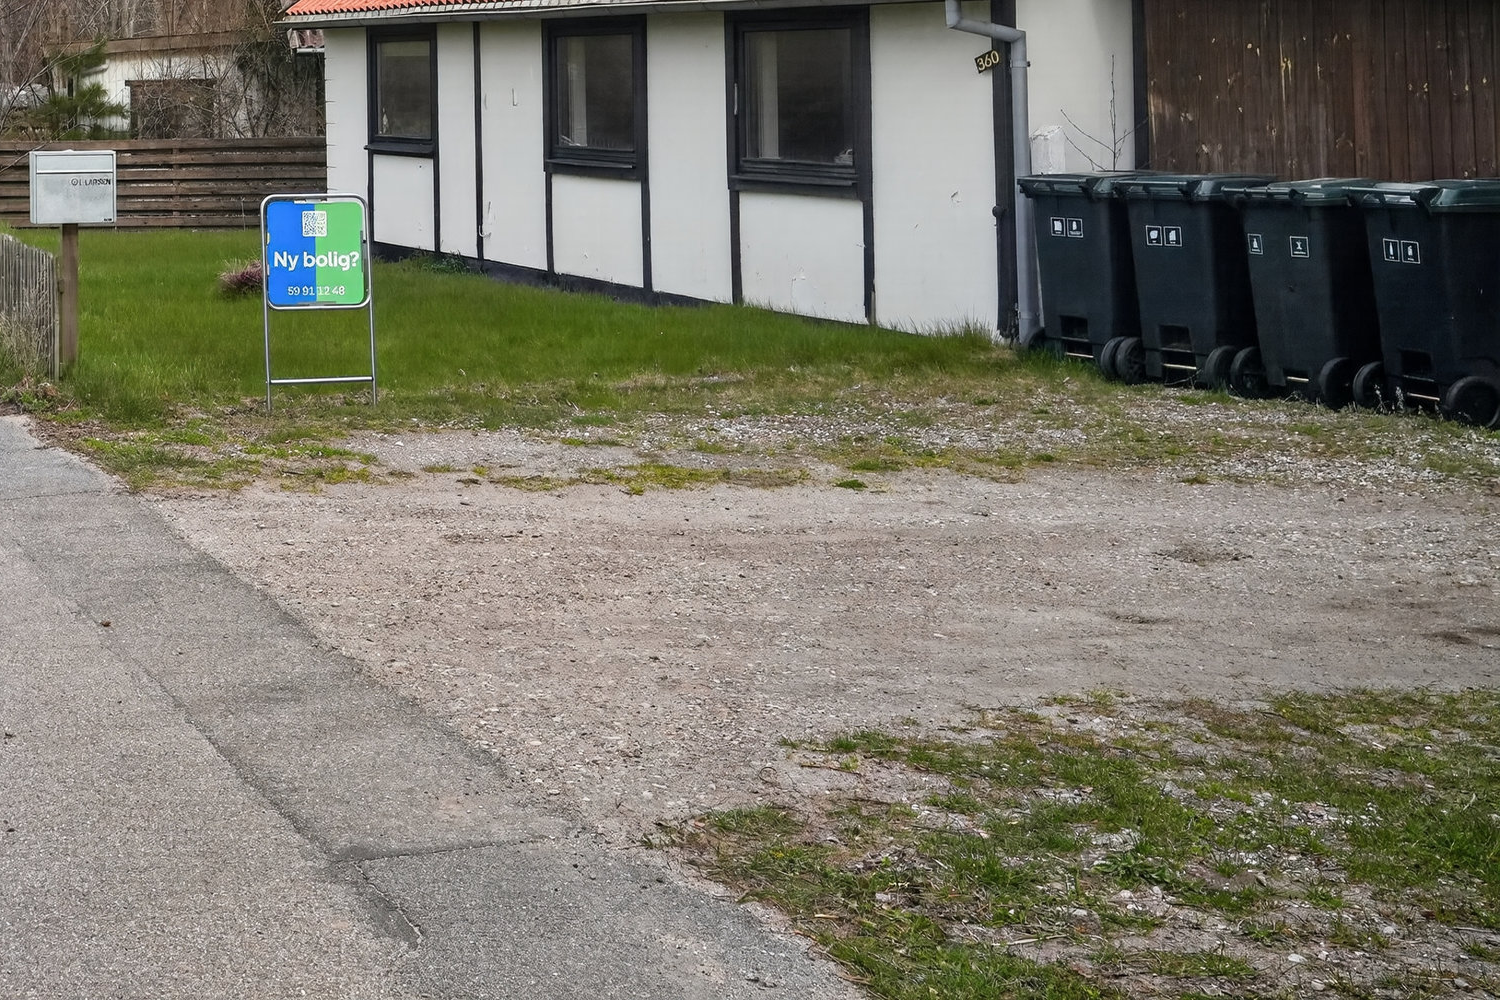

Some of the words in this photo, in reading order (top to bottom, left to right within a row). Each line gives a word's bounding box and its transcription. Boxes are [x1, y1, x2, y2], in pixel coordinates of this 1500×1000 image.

[976, 50, 1000, 71] 360
[273, 251, 299, 271] Ny
[303, 251, 360, 271] bolig?
[287, 286, 300, 296] 59
[302, 285, 315, 296] 91
[317, 286, 330, 296] 12
[332, 285, 345, 296] 48
